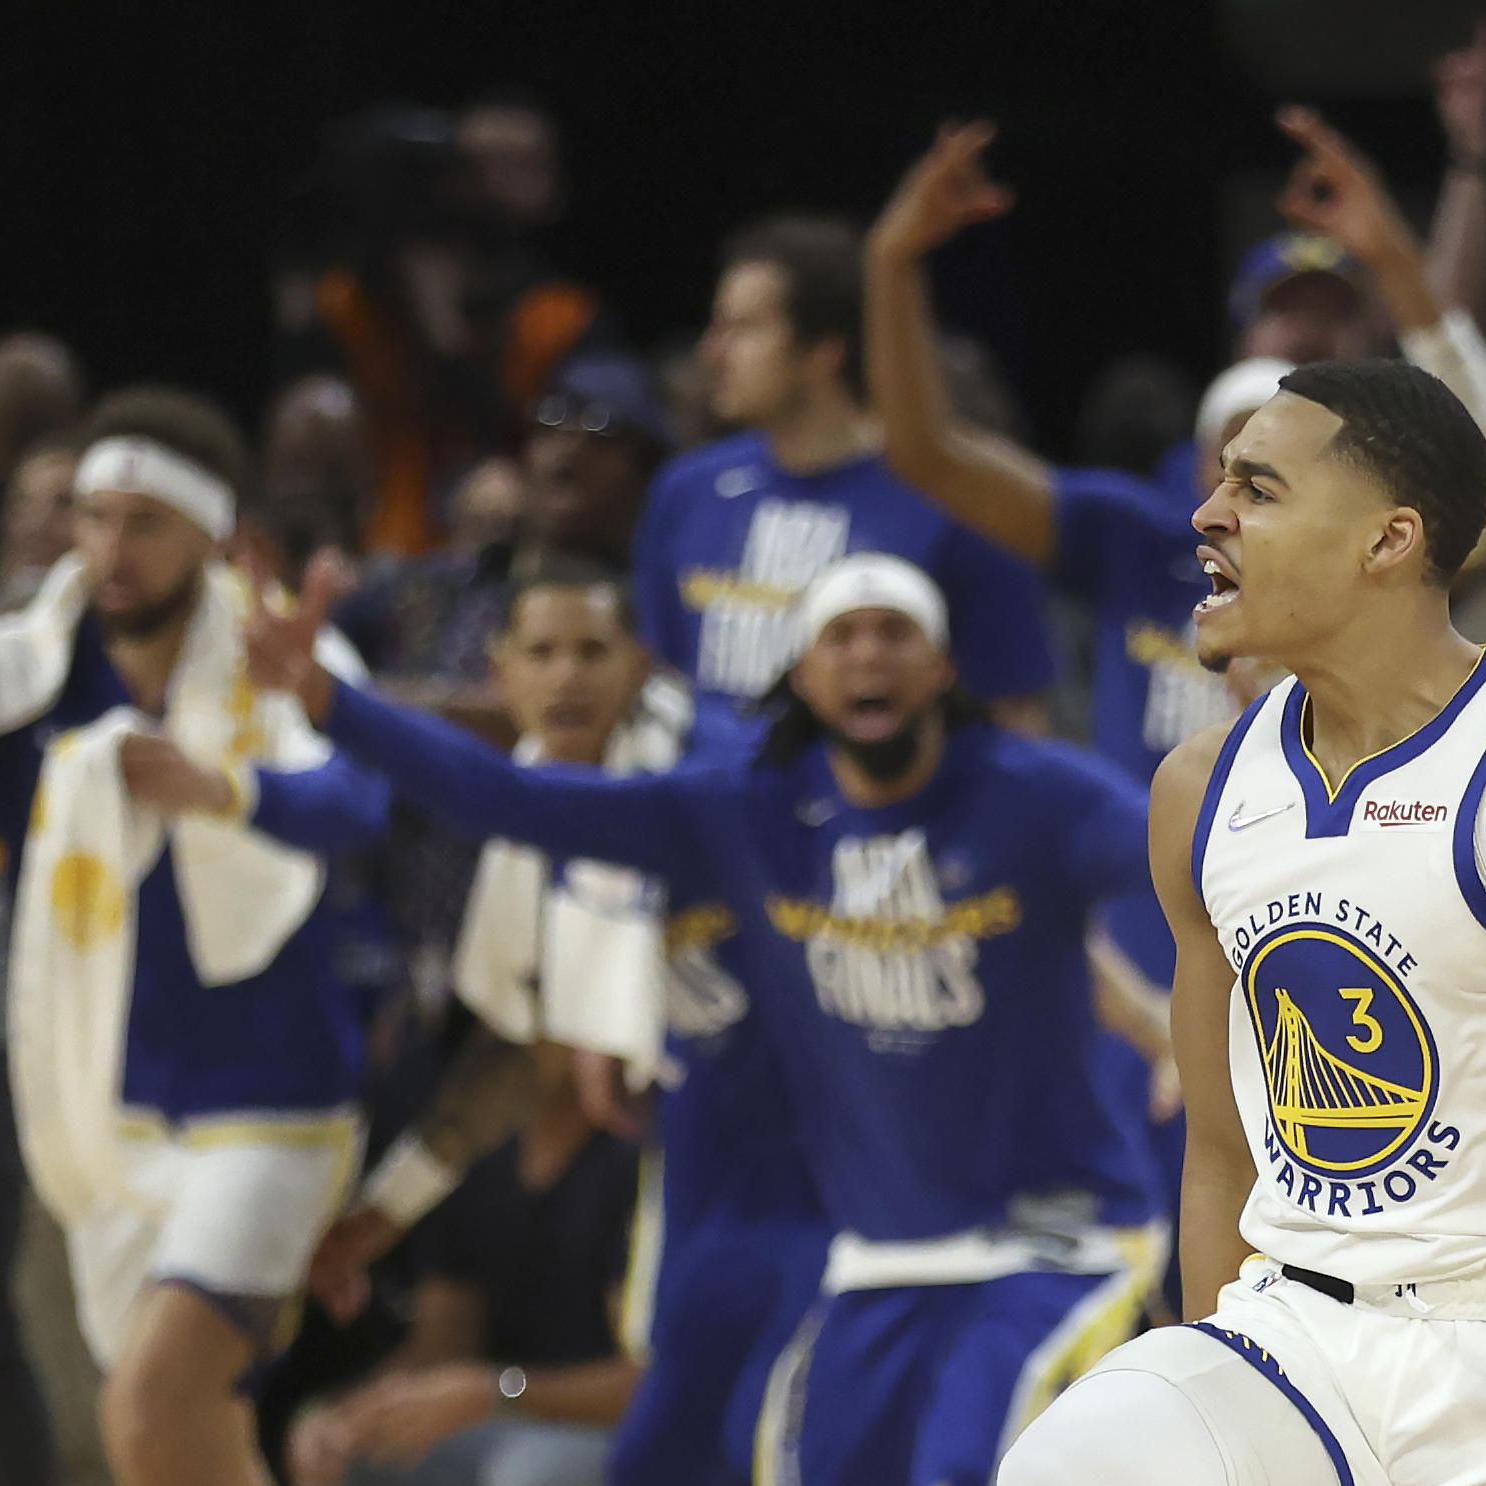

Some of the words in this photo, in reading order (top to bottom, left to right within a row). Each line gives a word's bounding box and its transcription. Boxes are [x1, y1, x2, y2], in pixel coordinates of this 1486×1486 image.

[1363, 800, 1448, 824] Rakuten
[1231, 891, 1322, 970] GOLDEN
[1336, 899, 1418, 978] STATE
[1337, 987, 1384, 1054] 3
[1264, 1113, 1462, 1218] WARRIORS
